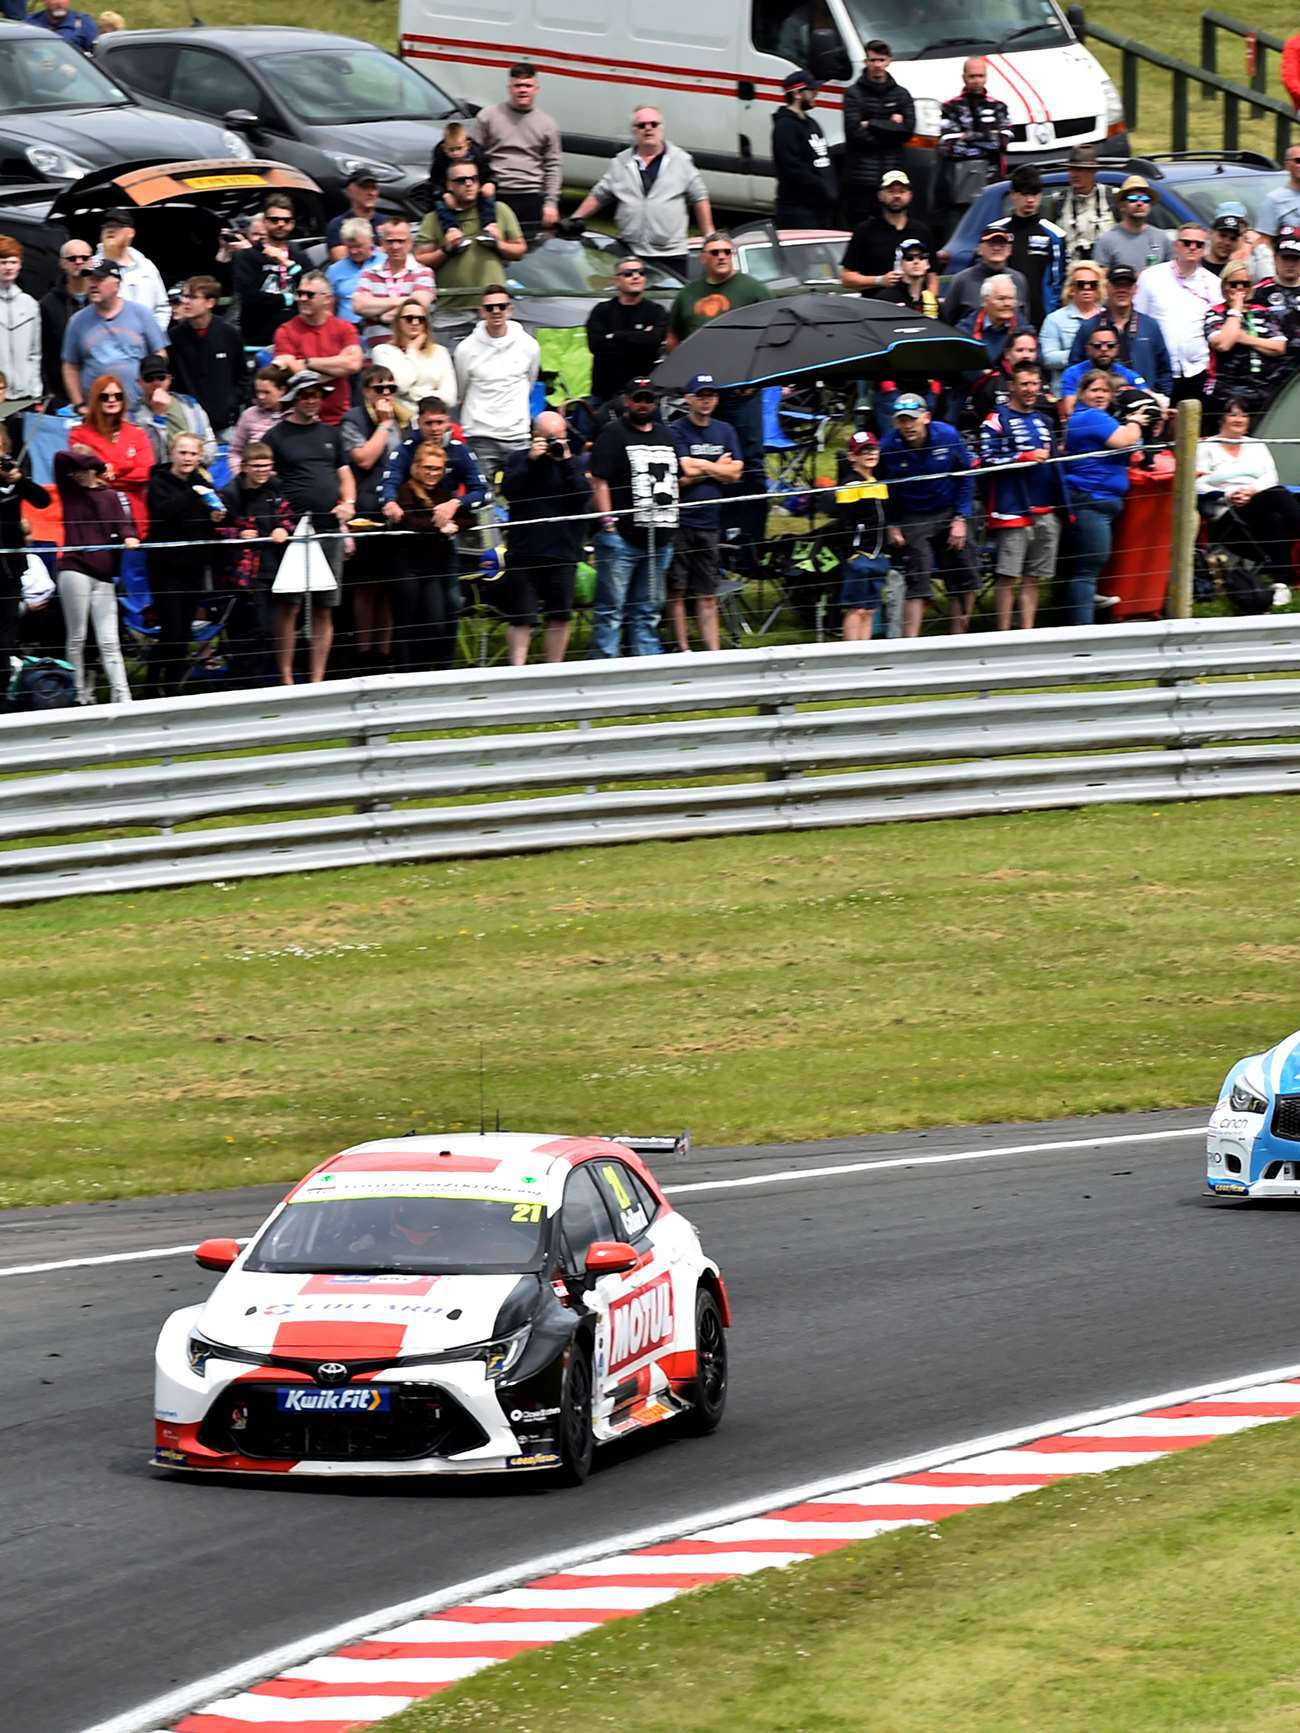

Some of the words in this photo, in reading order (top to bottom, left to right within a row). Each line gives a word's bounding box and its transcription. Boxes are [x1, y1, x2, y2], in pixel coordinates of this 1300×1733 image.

[1220, 1119, 1248, 1129] cinch
[511, 1204, 542, 1223] 21
[610, 1281, 673, 1366] MOTUL
